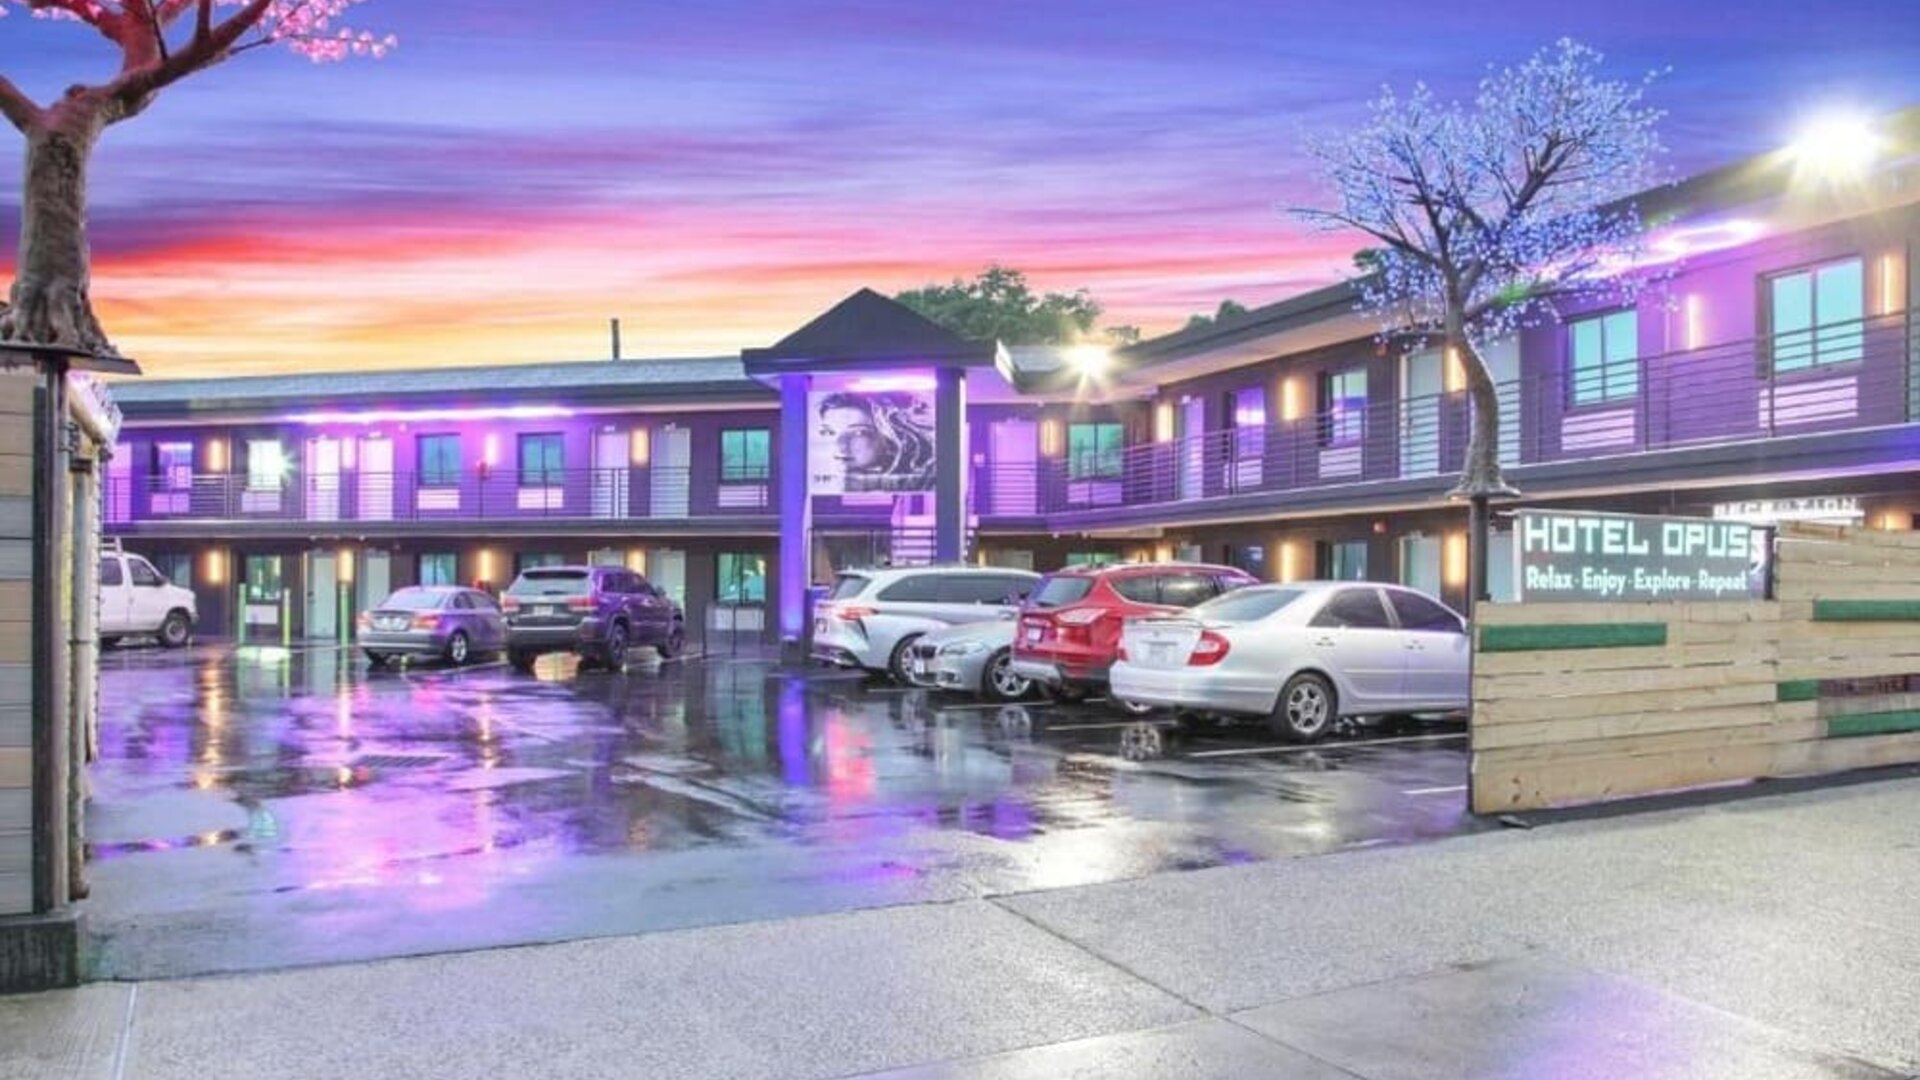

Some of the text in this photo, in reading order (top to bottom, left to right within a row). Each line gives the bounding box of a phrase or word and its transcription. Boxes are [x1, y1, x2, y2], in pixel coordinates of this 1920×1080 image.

[1525, 516, 1748, 557] HOTEL OPUS
[1526, 564, 1746, 597] Relax Enjoy Explore Repeat
